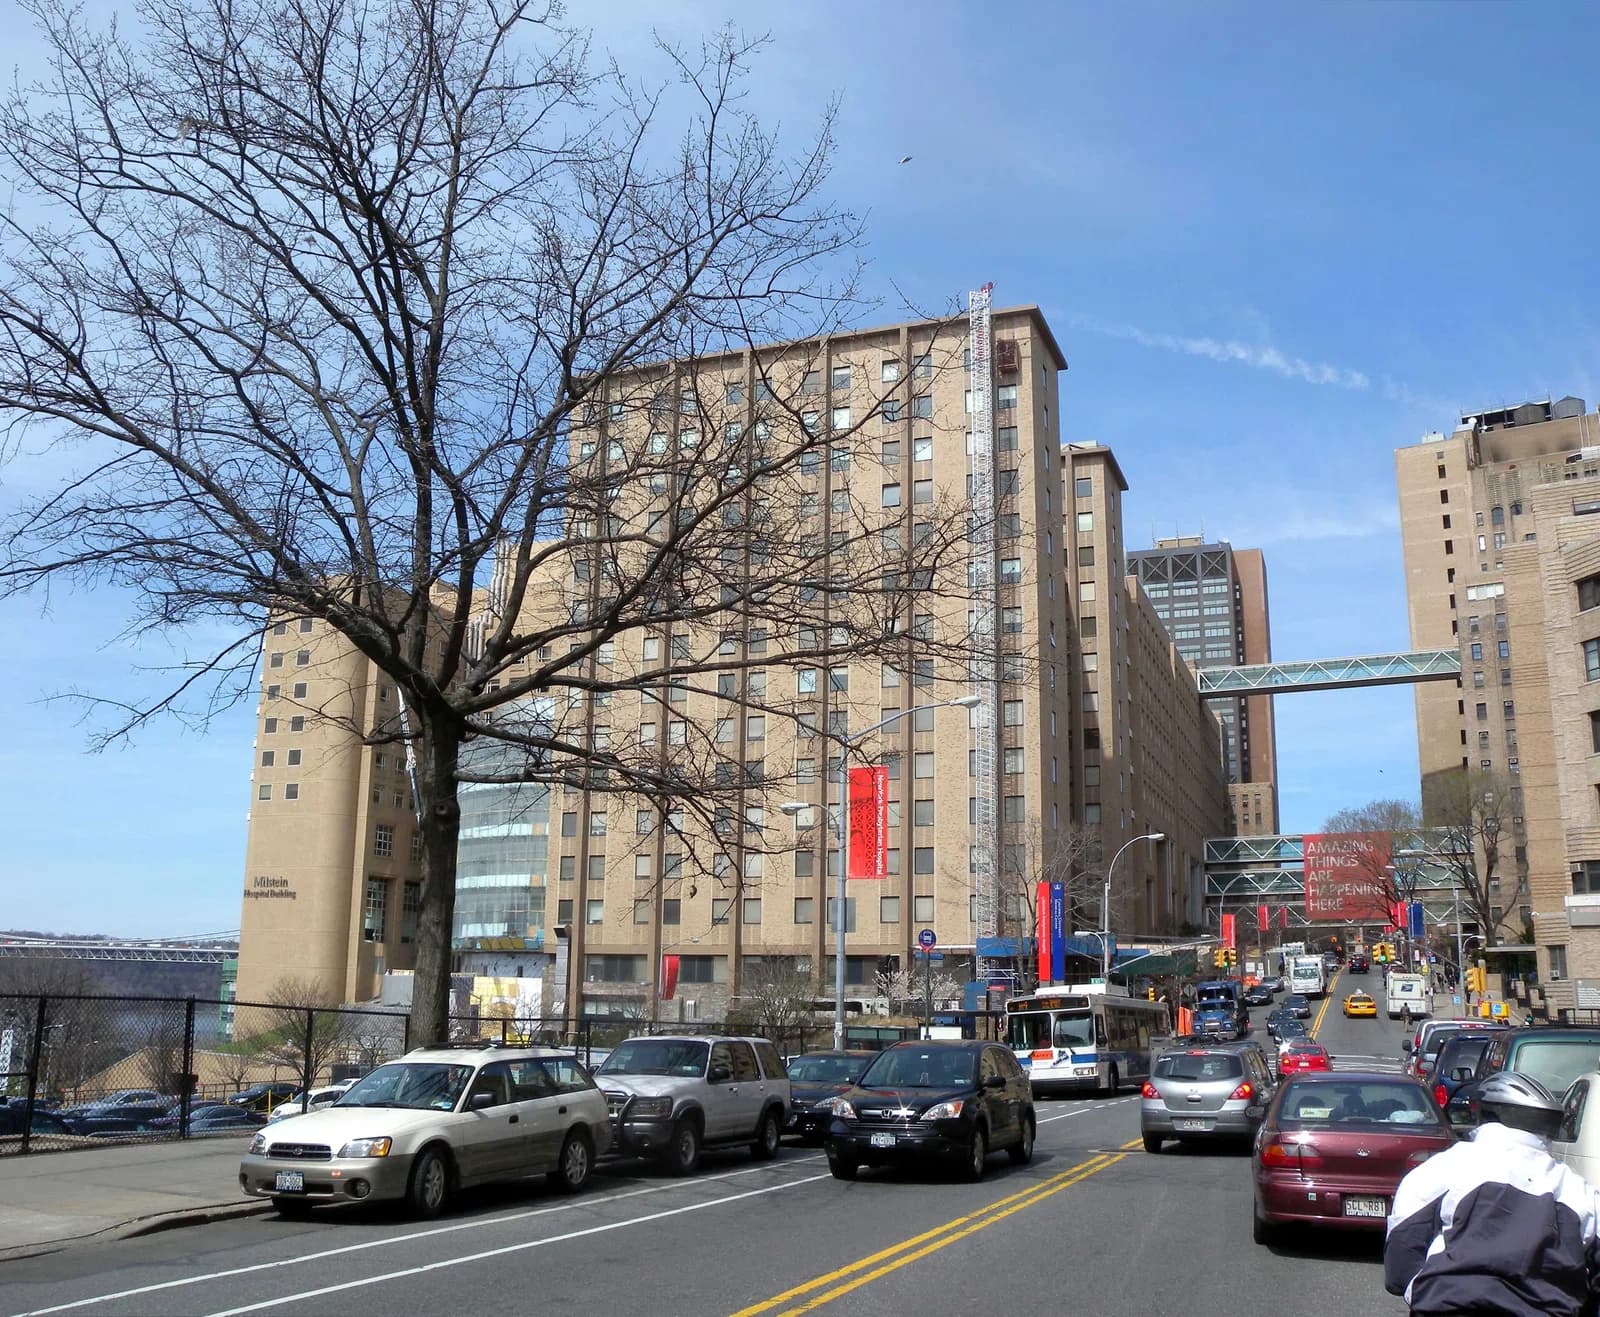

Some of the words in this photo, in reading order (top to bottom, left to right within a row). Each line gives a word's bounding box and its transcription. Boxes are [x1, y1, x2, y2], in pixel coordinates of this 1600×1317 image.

[1307, 840, 1374, 854] AMAZING
[876, 848, 884, 875] Hospital
[1307, 854, 1360, 867] THINGS
[254, 876, 288, 888] Milstein
[1308, 870, 1334, 882] ARE
[244, 889, 270, 900] Hospital
[270, 889, 296, 900] Building
[1309, 883, 1386, 897] HAPPENING
[1309, 898, 1344, 911] HERE
